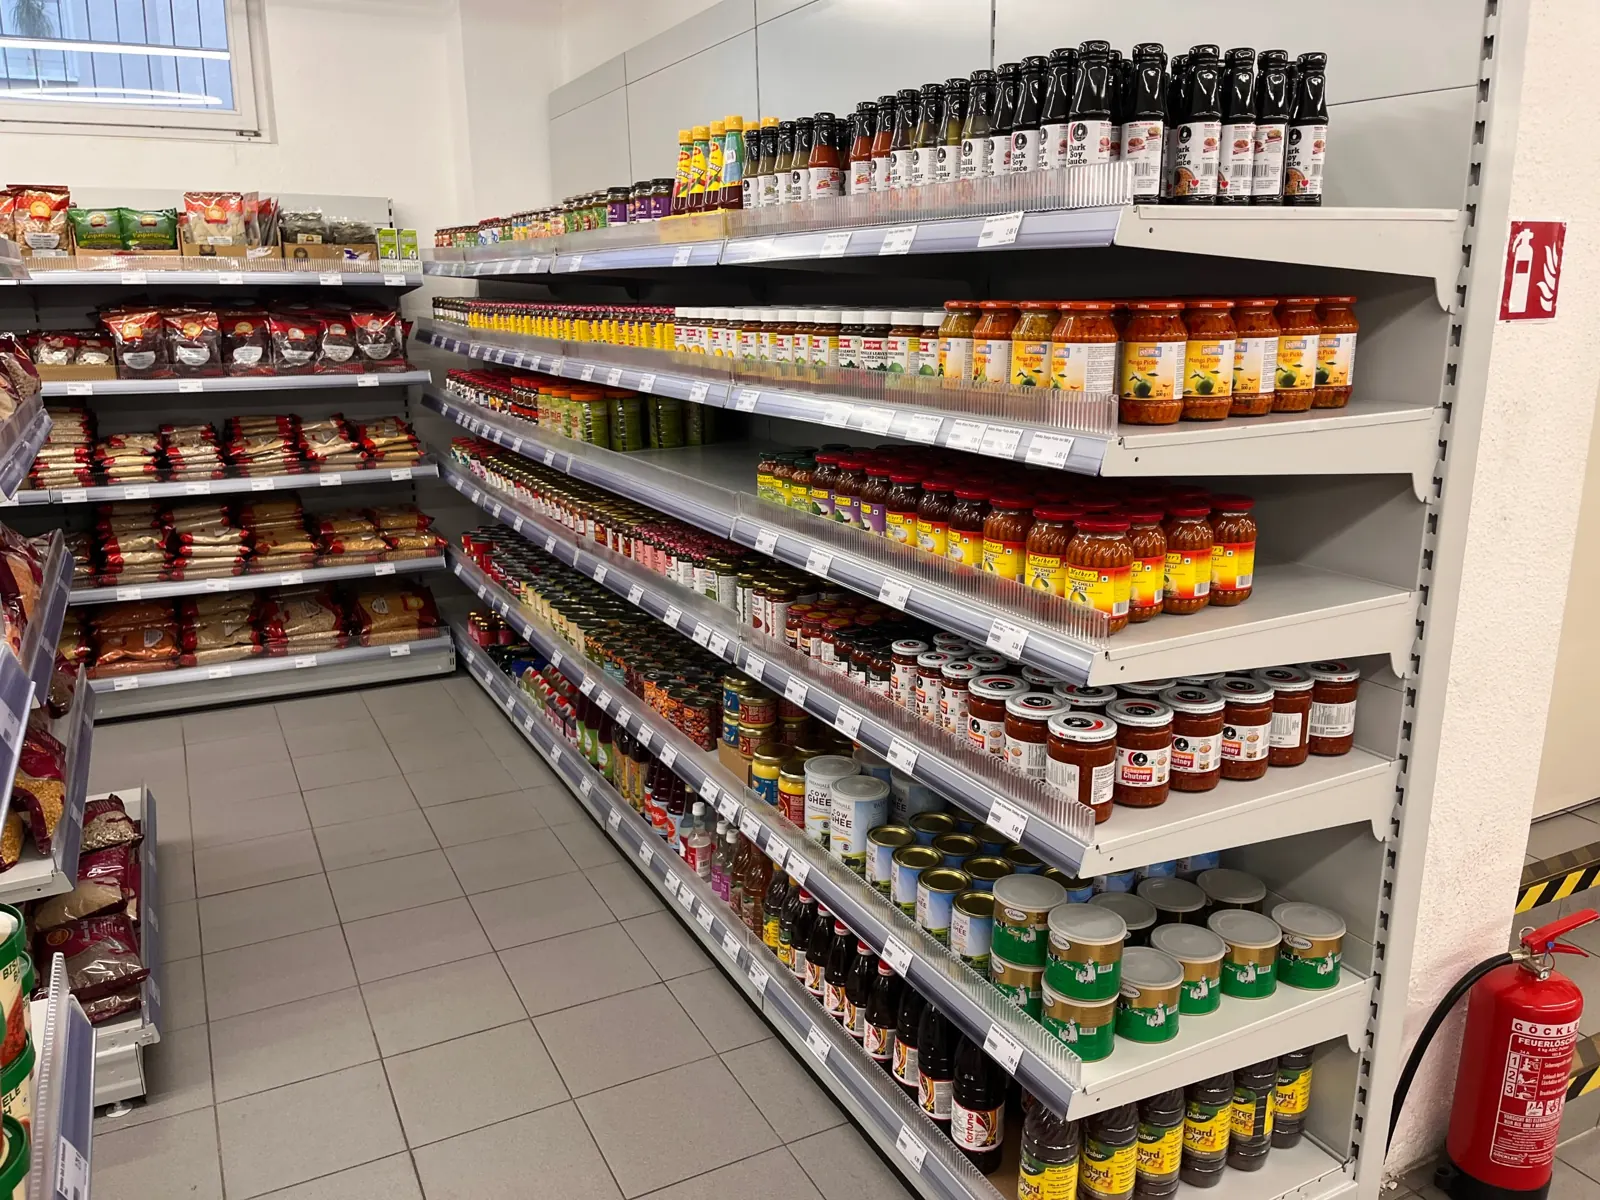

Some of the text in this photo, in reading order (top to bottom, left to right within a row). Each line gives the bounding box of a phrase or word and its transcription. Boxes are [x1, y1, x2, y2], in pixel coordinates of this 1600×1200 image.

[1069, 144, 1086, 152] Dark
[1031, 556, 1058, 565] Mother's
[1070, 569, 1096, 578] Mother's
[1221, 746, 1239, 754] utney
[1171, 758, 1191, 766] hutney
[811, 790, 827, 798] COW
[808, 794, 831, 807] GHEE
[892, 801, 906, 812] HEE
[833, 809, 847, 819] COW
[832, 813, 852, 828] GHEE
[1286, 935, 1311, 947] Khanum
[1514, 1022, 1578, 1035] GÖCKLE
[1508, 1071, 1515, 1080] 2
[1506, 1085, 1513, 1094] 3
[1276, 1091, 1294, 1099] tard
[1537, 1101, 1543, 1109] A
[1187, 1112, 1210, 1120] Dabur
[965, 1113, 974, 1143] fortune
[1184, 1124, 1212, 1137] ustard
[1185, 1131, 1202, 1144] Oil
[1086, 1148, 1106, 1158] Dabur
[1137, 1148, 1160, 1159] stard
[1086, 1163, 1109, 1178] stard
[1084, 1169, 1100, 1183] Oil
[1022, 1180, 1040, 1194] tard
